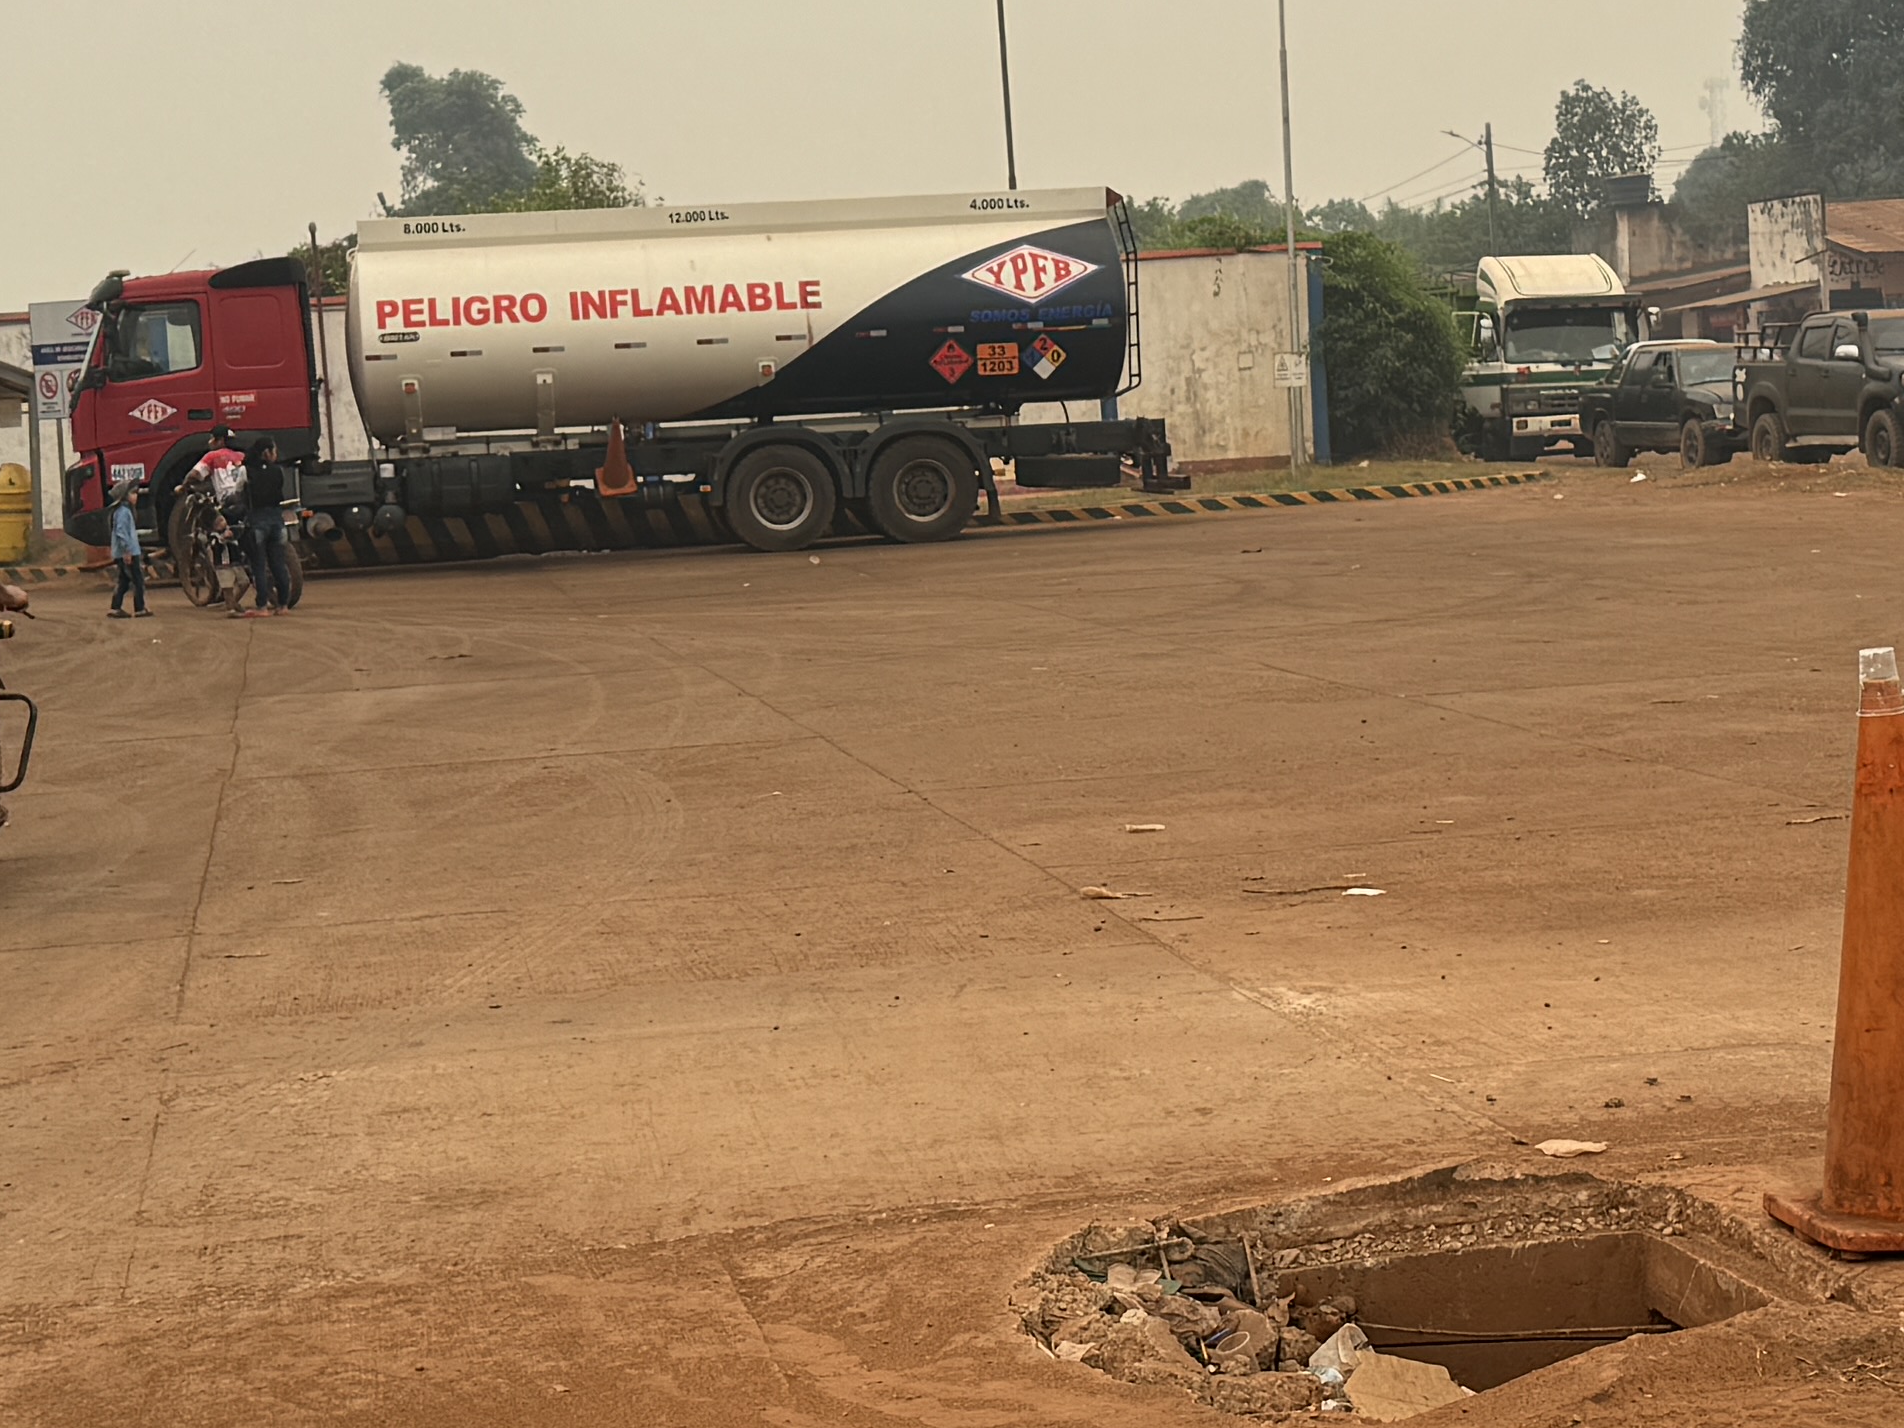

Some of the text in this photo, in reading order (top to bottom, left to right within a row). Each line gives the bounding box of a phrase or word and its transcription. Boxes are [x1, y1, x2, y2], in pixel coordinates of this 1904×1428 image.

[969, 197, 1030, 211] 4.000 Lts.
[668, 209, 729, 224] 12.000 Lts.
[403, 222, 466, 234] 8.000 Lts.
[985, 252, 1072, 292] YPFB
[376, 280, 823, 330] PELIGRO INFLAMABLE
[969, 308, 1031, 323] SOMOS
[1039, 337, 1048, 350] 2
[988, 345, 1006, 357] 33
[1051, 349, 1062, 363] 0
[981, 360, 1014, 373] 1203
